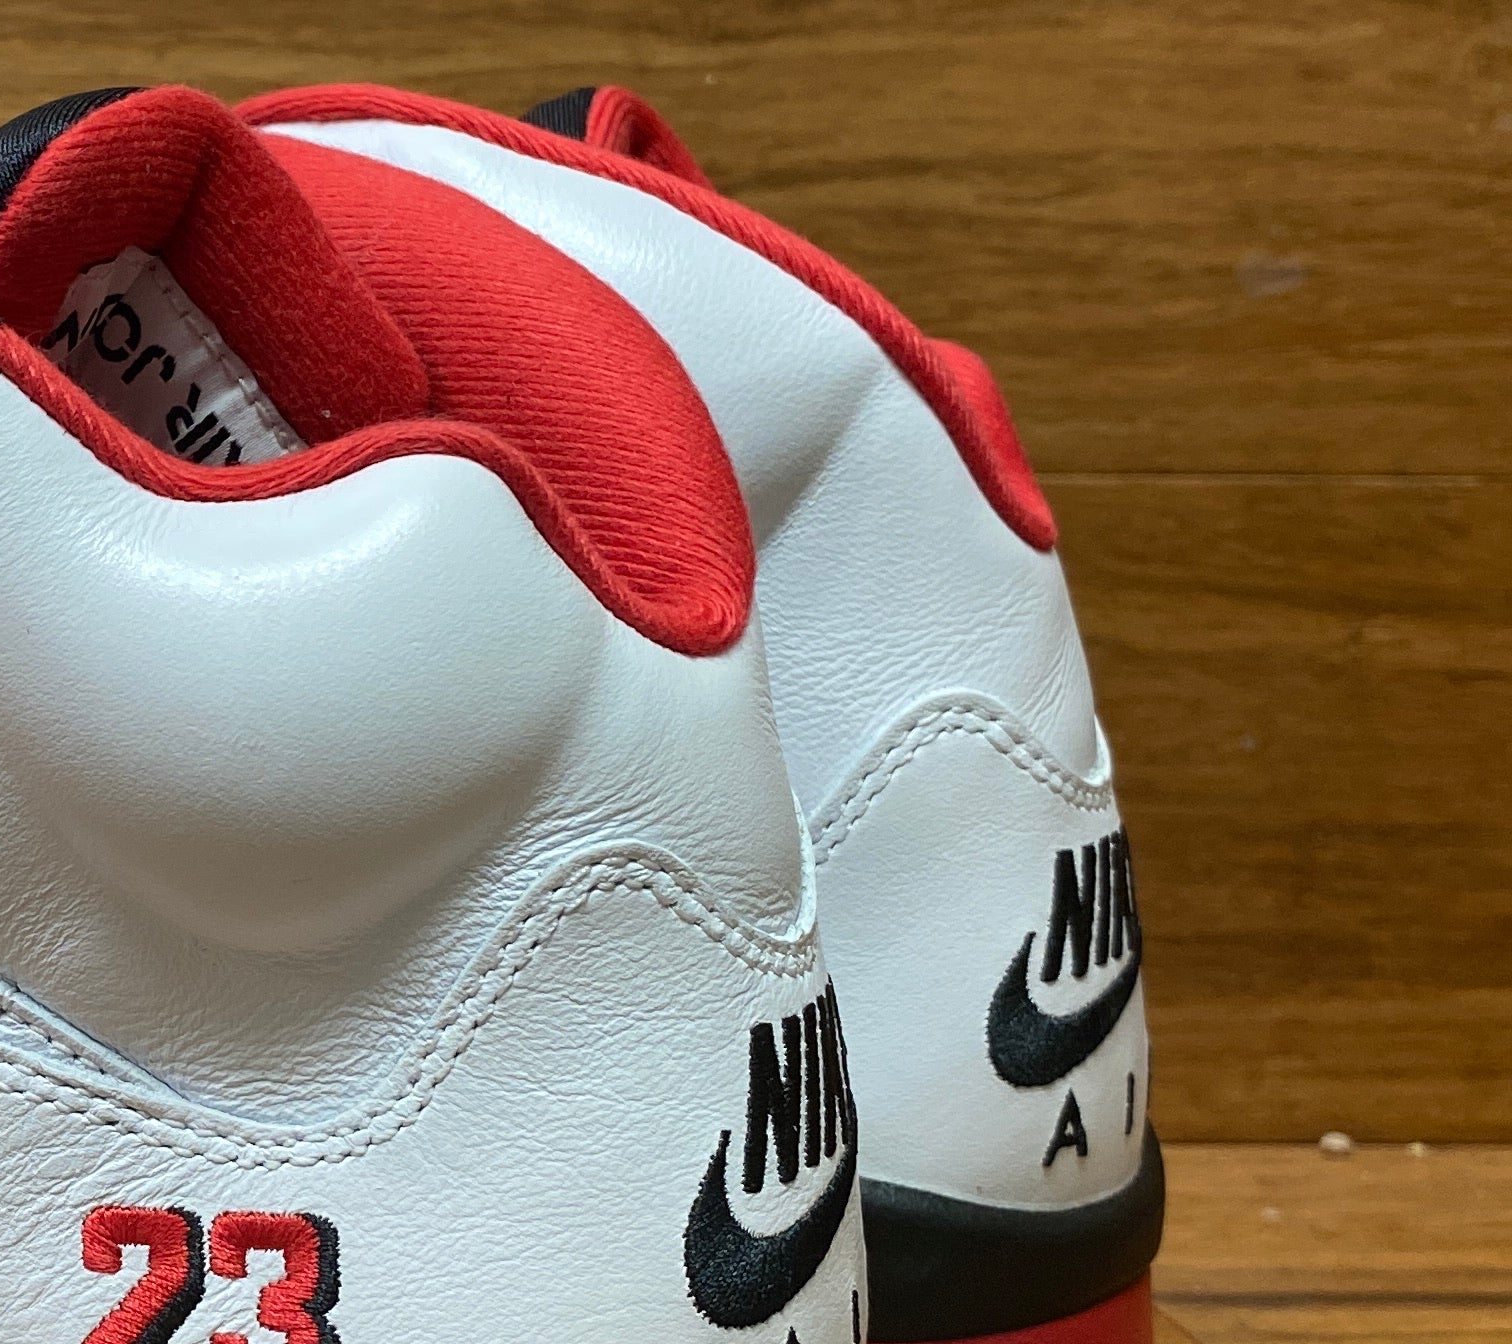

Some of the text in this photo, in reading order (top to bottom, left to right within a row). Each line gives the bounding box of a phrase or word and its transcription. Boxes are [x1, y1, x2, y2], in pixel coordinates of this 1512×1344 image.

[1040, 824, 1142, 983] NIK
[742, 973, 858, 1193] NIK
[1042, 1071, 1136, 1167] AI
